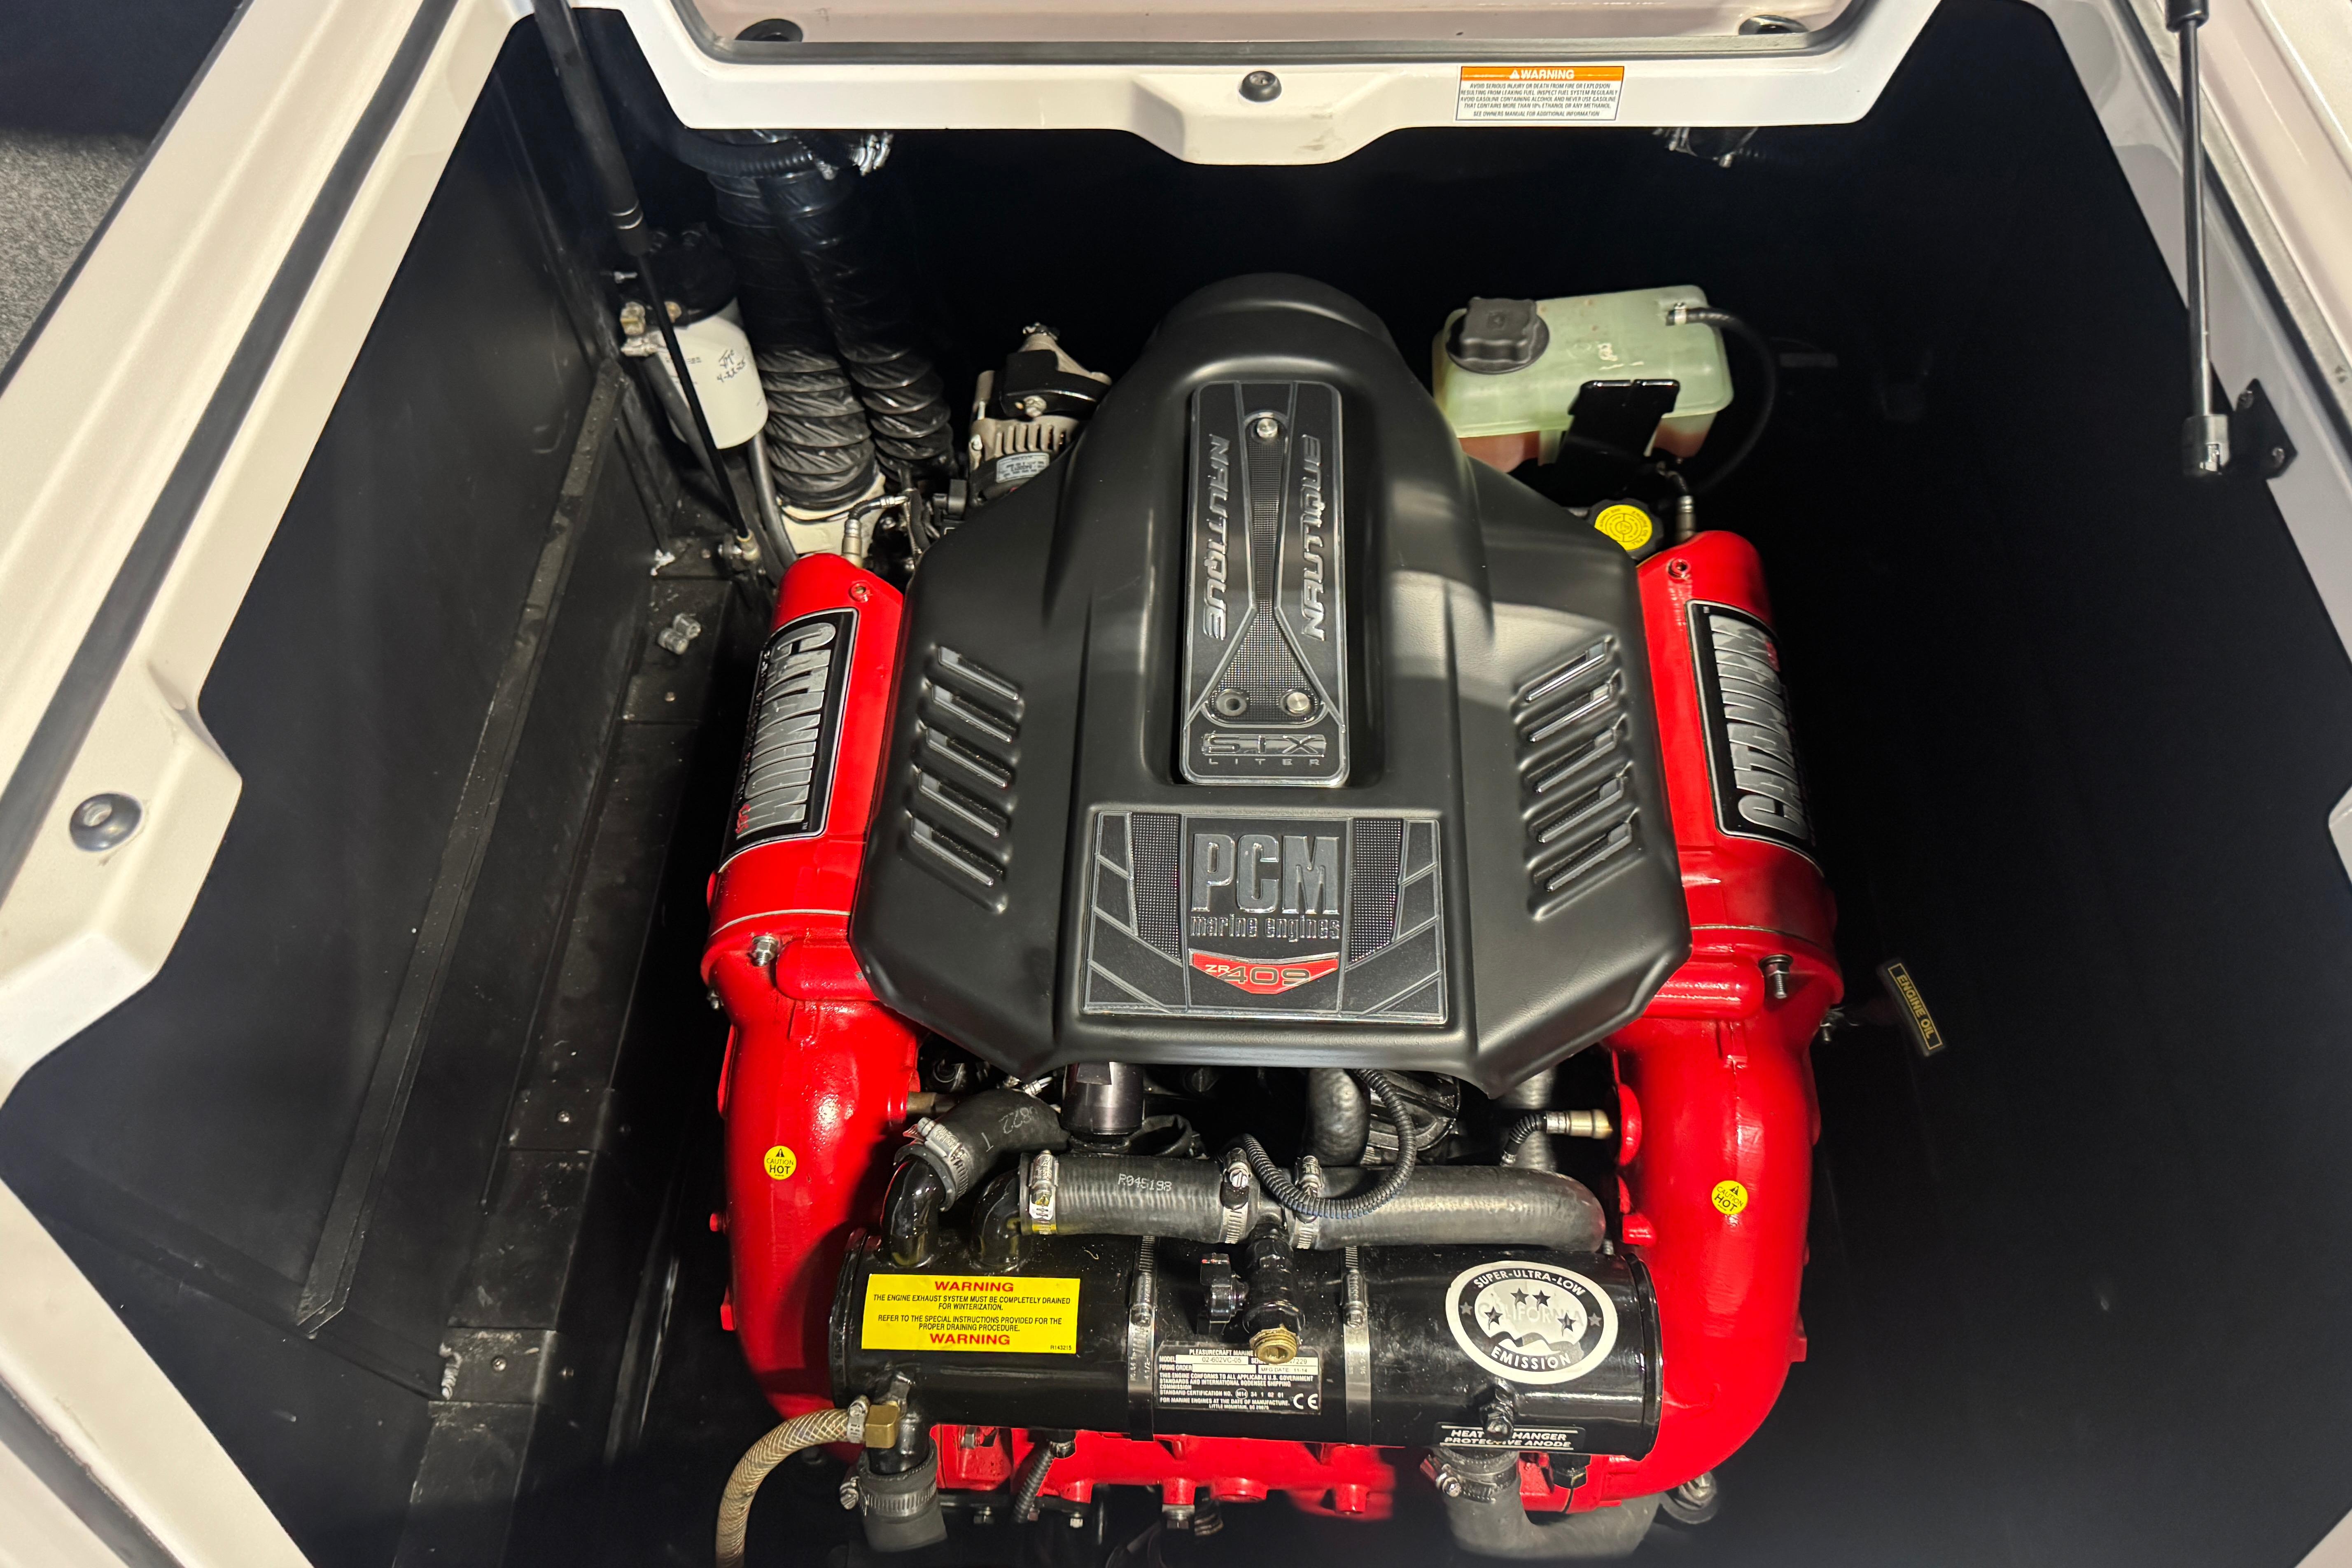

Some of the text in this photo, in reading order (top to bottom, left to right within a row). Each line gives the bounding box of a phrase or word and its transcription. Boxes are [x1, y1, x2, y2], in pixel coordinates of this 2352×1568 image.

[1521, 70, 1575, 79] WARNING
[1203, 433, 1231, 641] NAUTIQUE
[1302, 434, 1324, 641] NAUTIQUE
[736, 622, 836, 840] CATANIUM
[1709, 614, 1808, 840] CATANIUM
[1192, 833, 1340, 915] PCM
[1190, 914, 1340, 943] marine engines
[1897, 974, 1935, 1039] ENGINE OIL
[770, 1164, 791, 1174] HOT
[1118, 1173, 1172, 1192] R045198
[1714, 1193, 1737, 1211] HOT
[1717, 1186, 1743, 1207] CAUTION
[935, 1281, 1014, 1292] WARNING
[1474, 1269, 1586, 1296] SUPER-ULTRA-LOW
[930, 1333, 1010, 1345] WARNING
[1491, 1346, 1571, 1370] EMISSION
[1293, 1393, 1318, 1410] CE
[1444, 1437, 1522, 1446] PROTECIVE
[1451, 1430, 1567, 1441] HEAT HANGER
